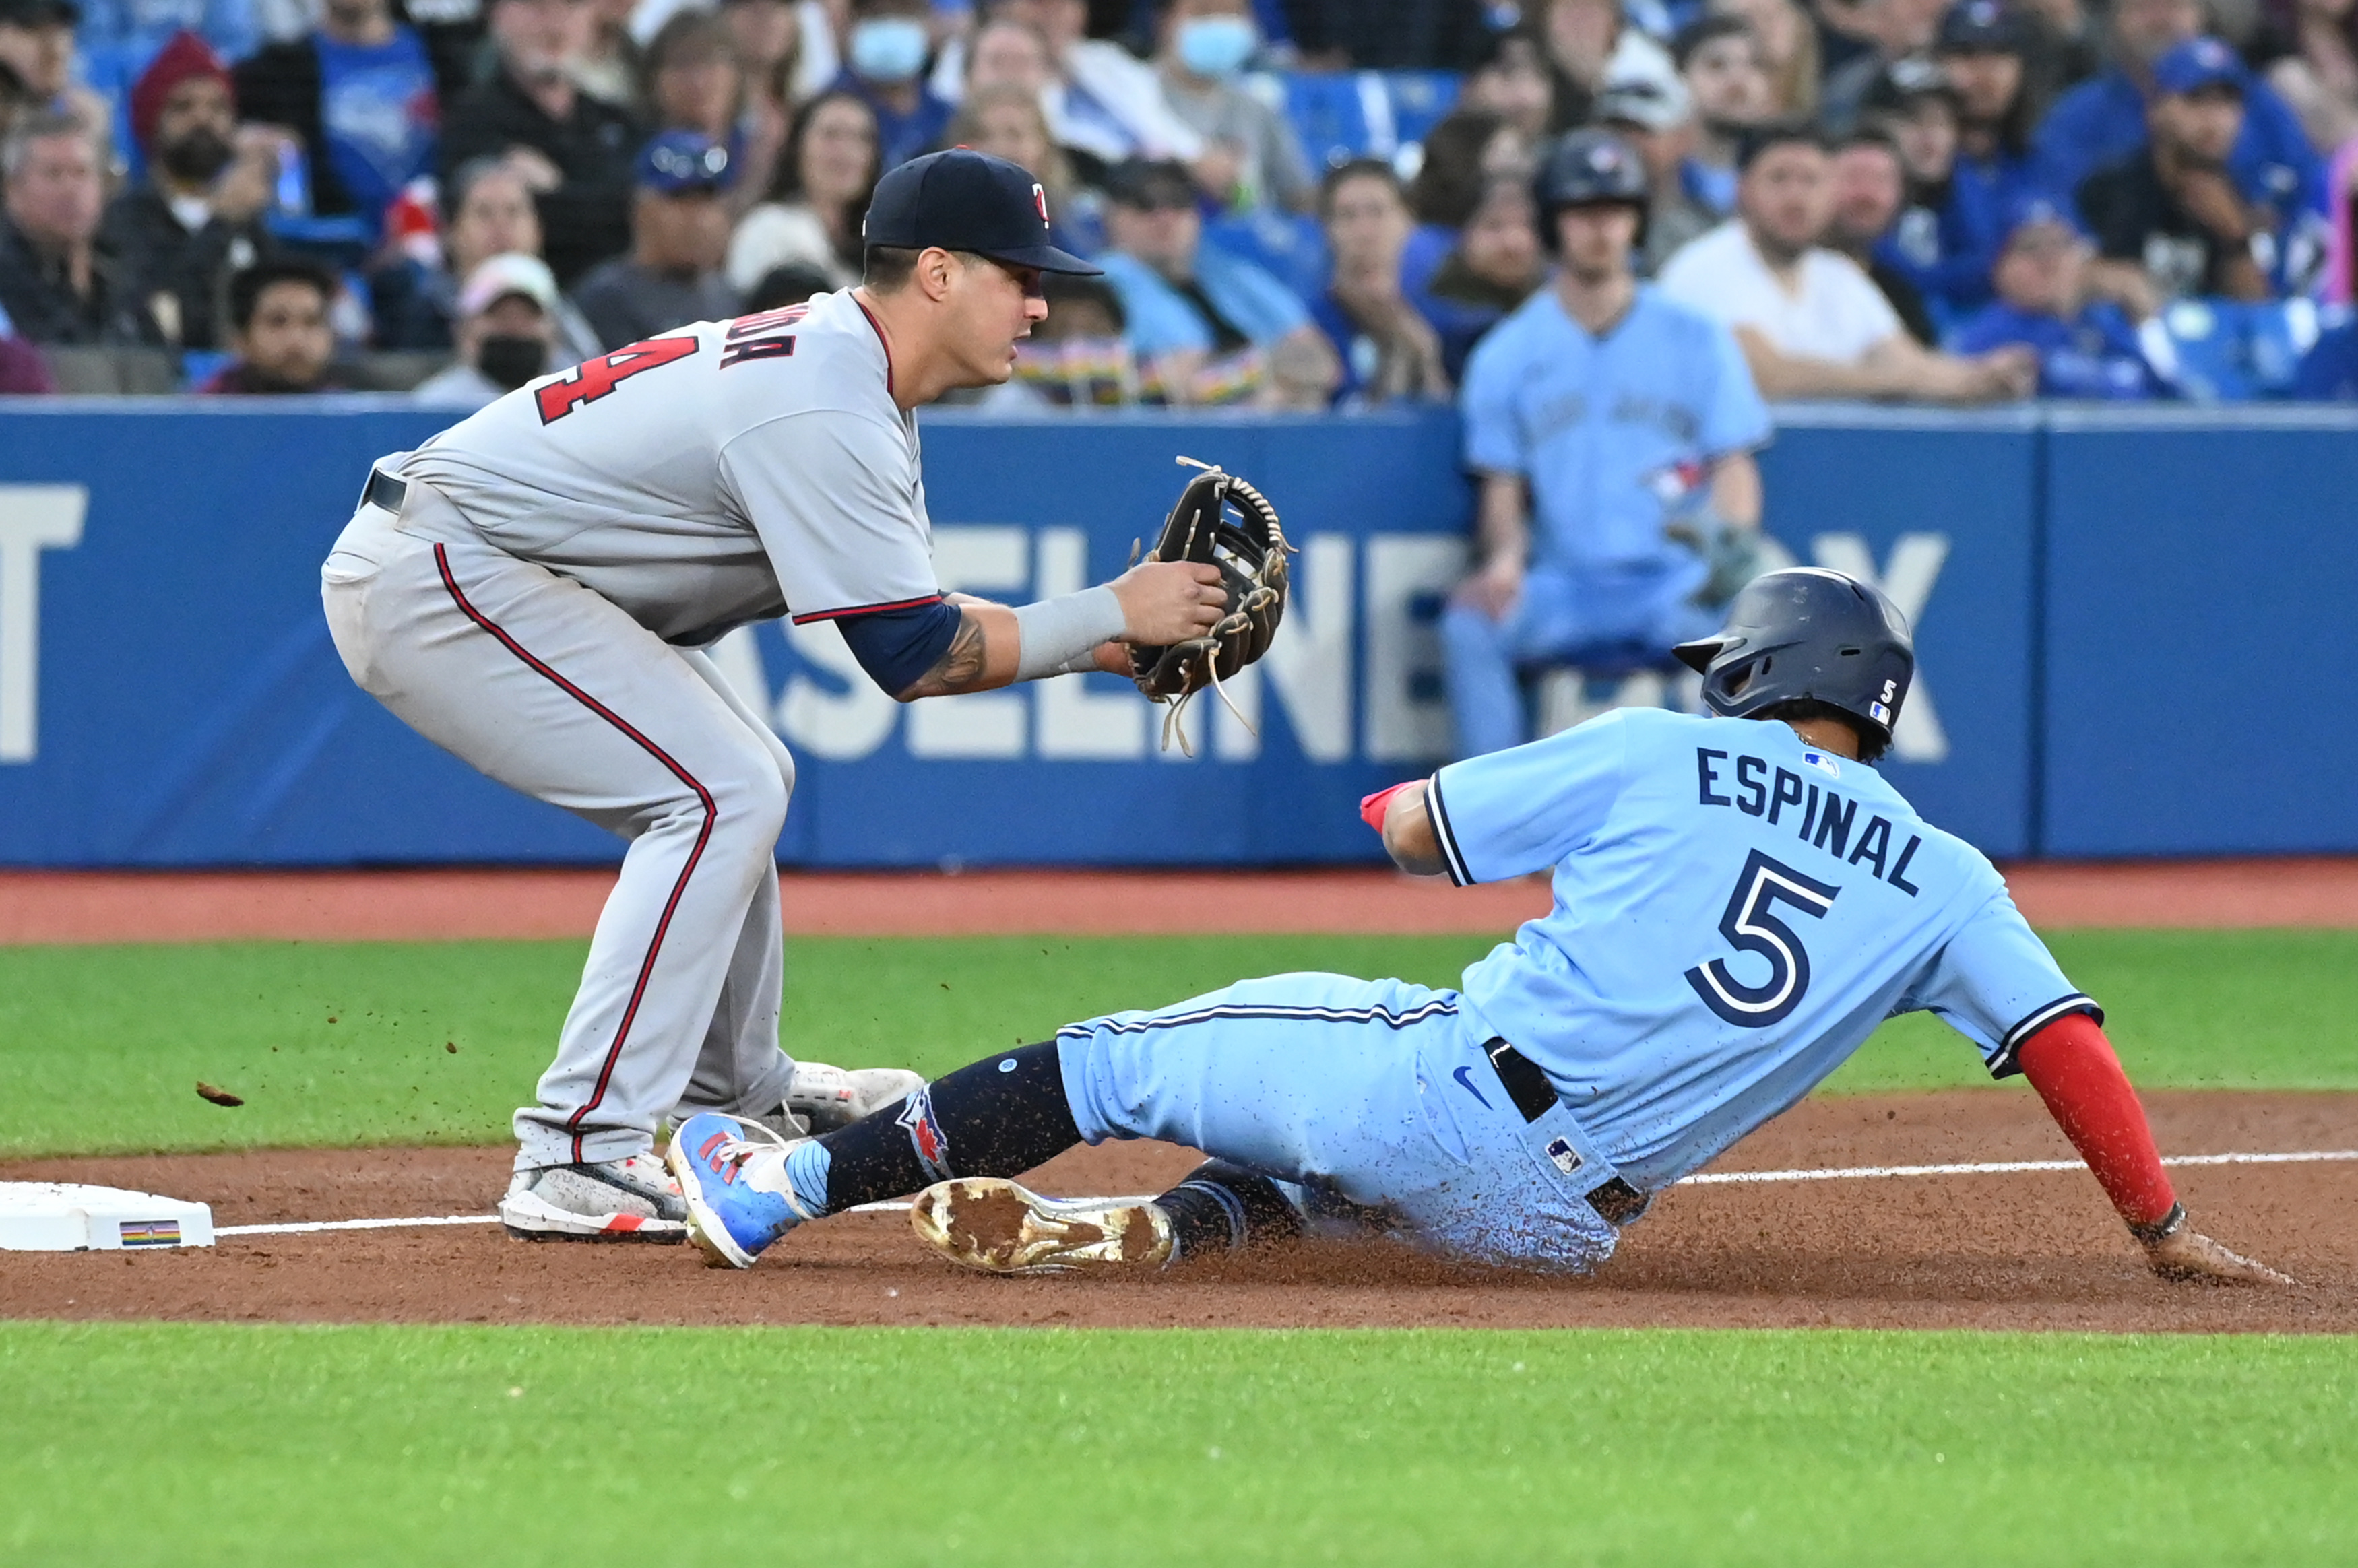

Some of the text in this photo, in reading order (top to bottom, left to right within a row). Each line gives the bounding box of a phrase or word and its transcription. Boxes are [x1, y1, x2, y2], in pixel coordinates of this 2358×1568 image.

[1880, 679, 1897, 704] 5
[1696, 746, 1923, 899] ESPINAL
[1684, 847, 1843, 1028] 5
